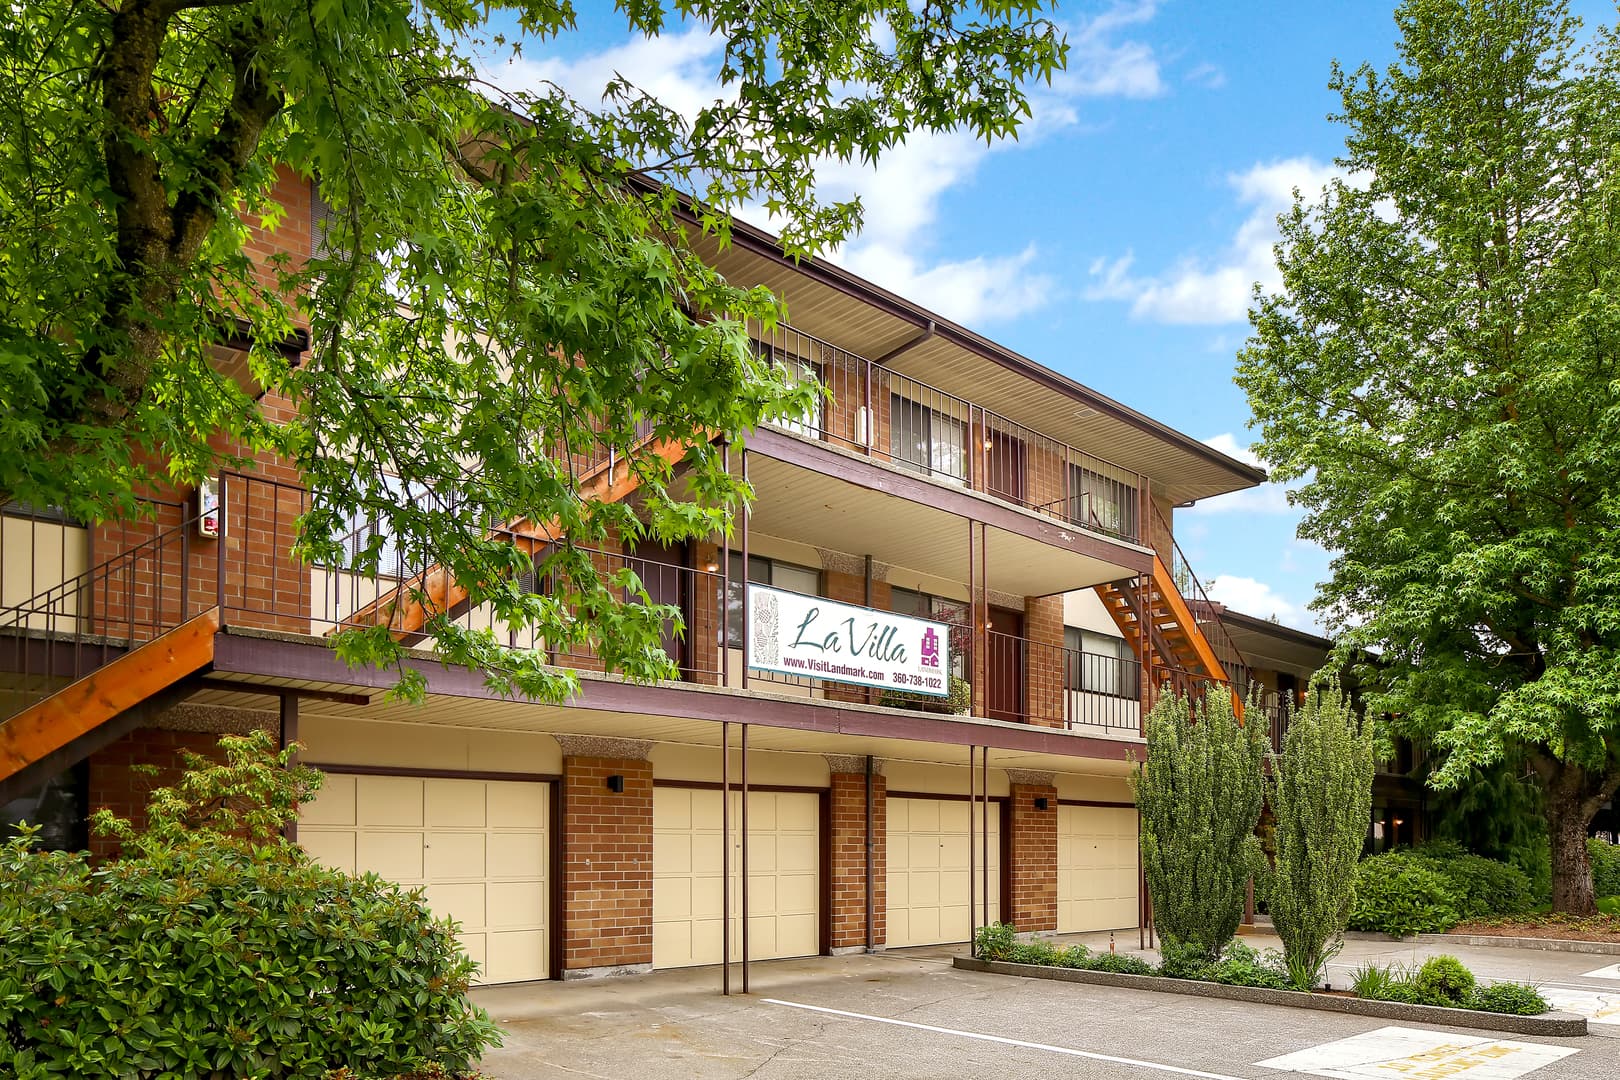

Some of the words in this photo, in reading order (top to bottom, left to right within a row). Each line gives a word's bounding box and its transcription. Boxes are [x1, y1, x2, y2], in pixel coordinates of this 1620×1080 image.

[788, 607, 842, 653] La
[840, 617, 908, 664] Villa
[783, 656, 885, 681] www.VisitLandmark.com
[892, 672, 942, 689] 360-738-1022
